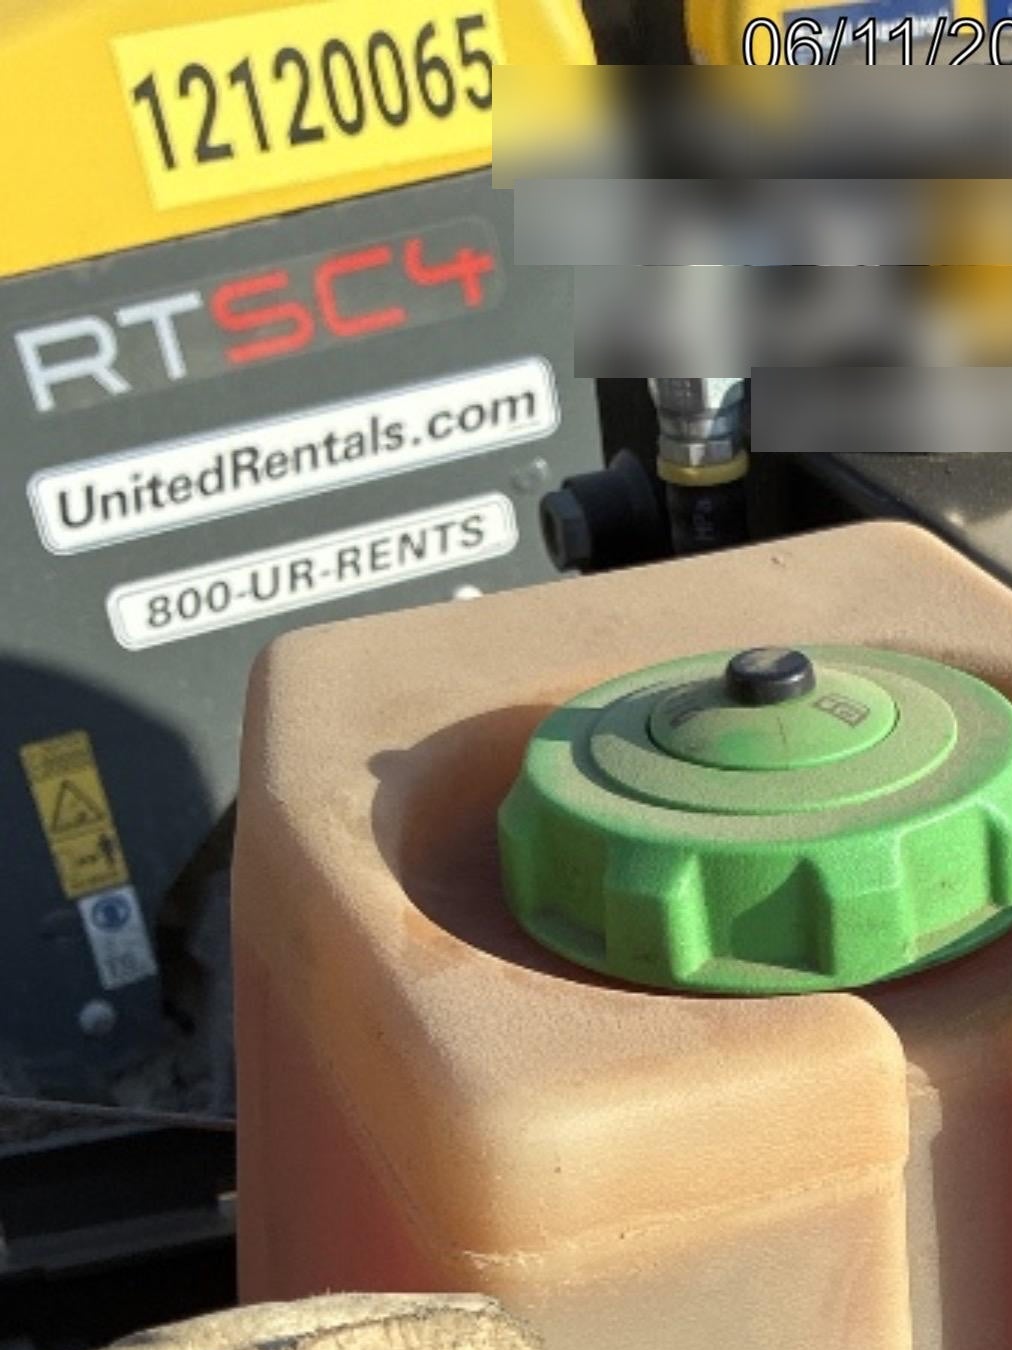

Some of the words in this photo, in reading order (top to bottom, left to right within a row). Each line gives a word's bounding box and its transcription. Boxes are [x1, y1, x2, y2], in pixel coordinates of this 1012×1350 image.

[131, 14, 493, 171] 12120065
[58, 390, 537, 530] UnitedRentals.com
[146, 514, 486, 630] 800-UR-RENTS
